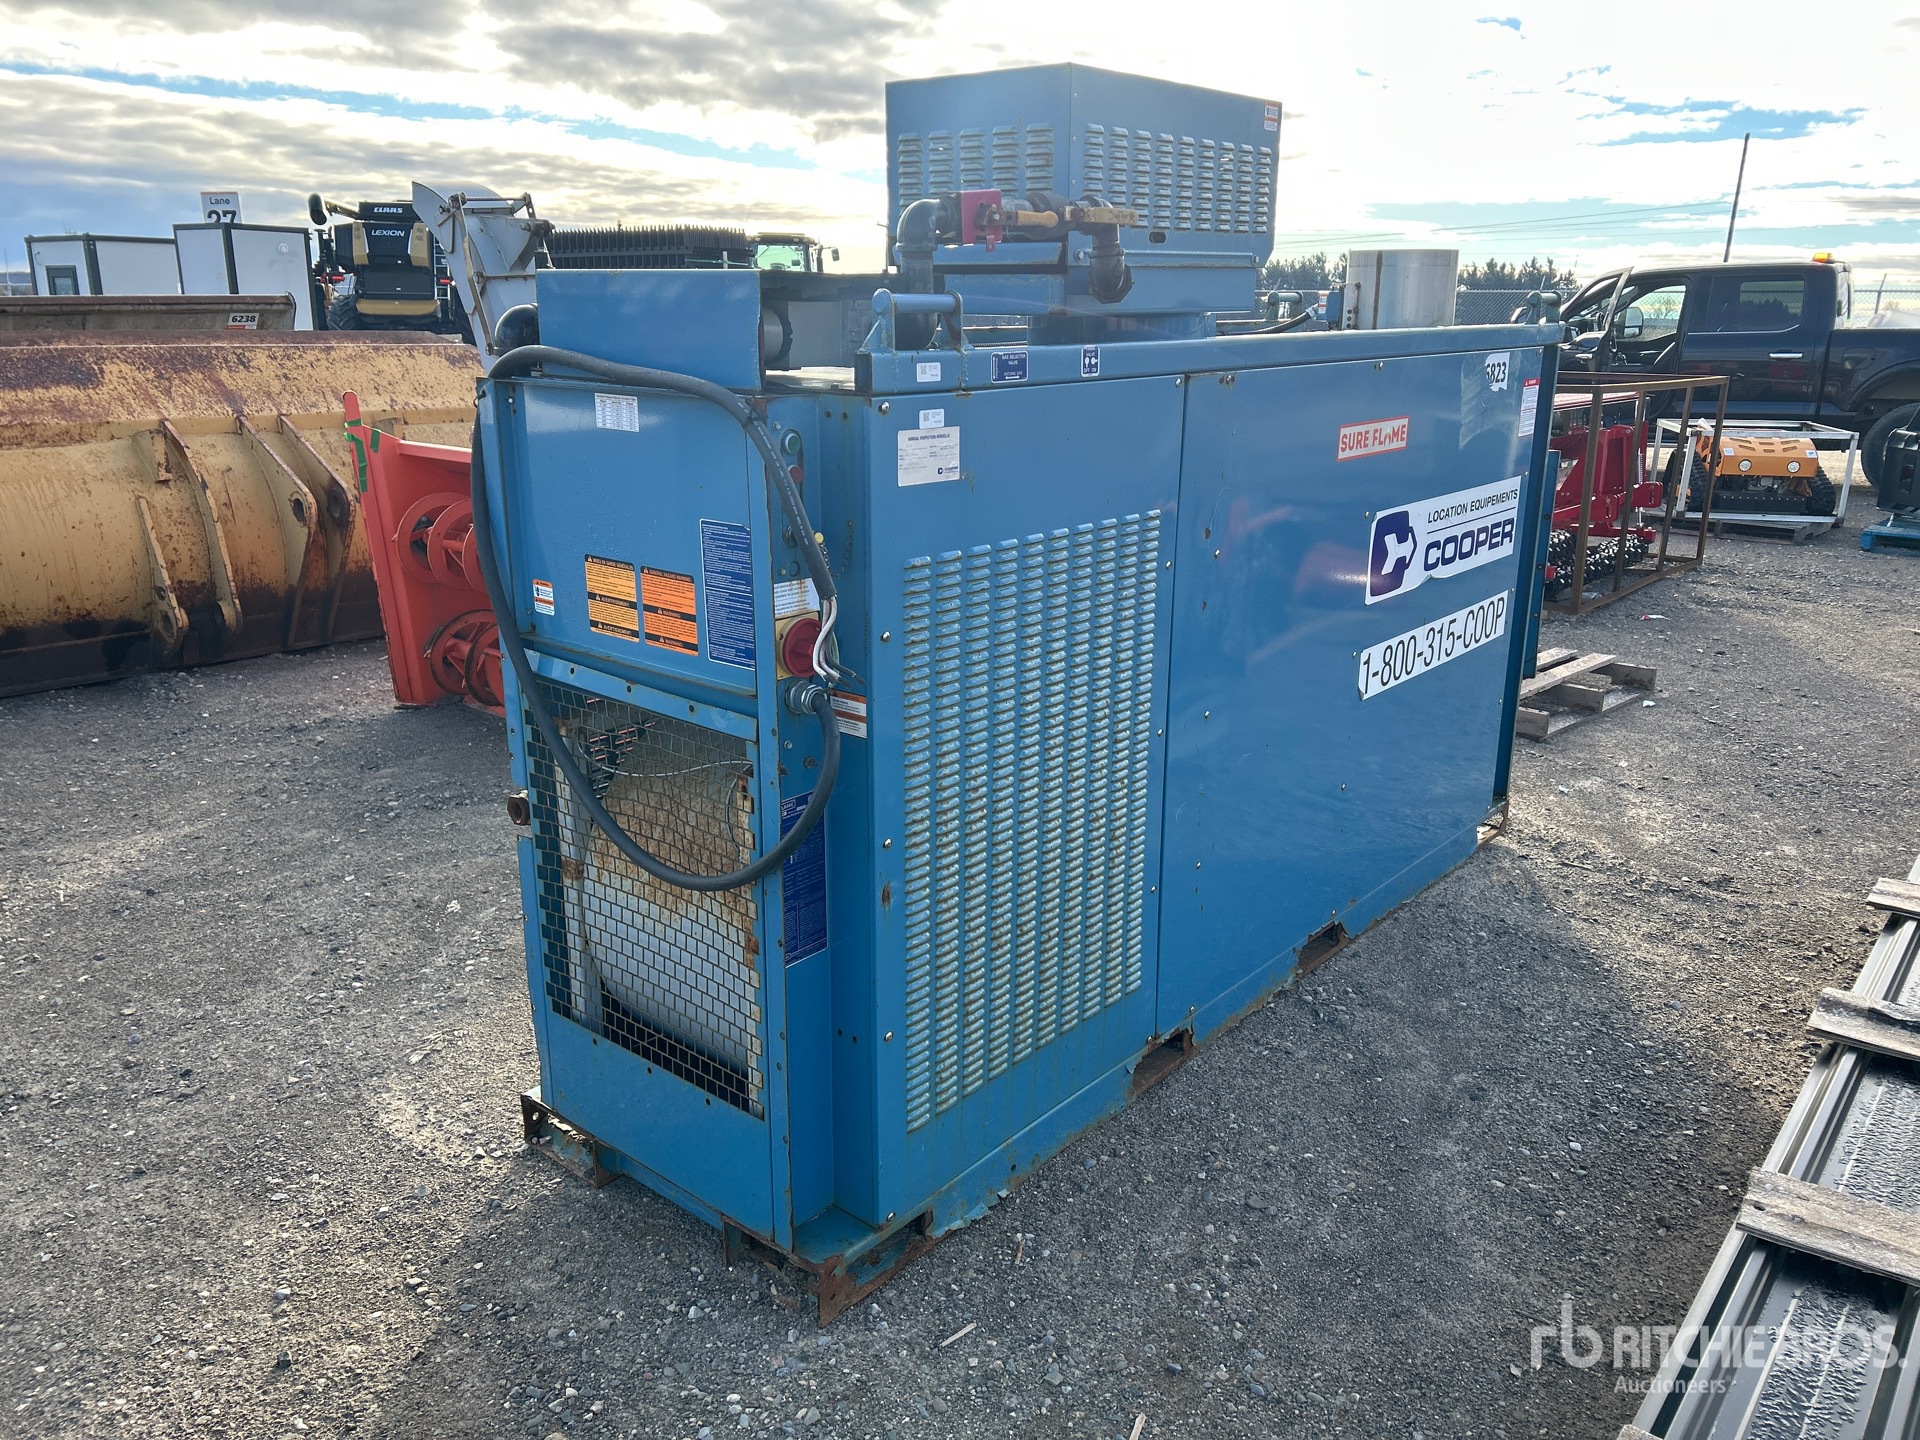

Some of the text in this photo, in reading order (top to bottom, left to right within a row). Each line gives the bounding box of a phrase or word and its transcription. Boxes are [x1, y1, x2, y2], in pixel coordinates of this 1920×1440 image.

[209, 197, 231, 205] Lane
[207, 209, 237, 224] 27
[371, 229, 405, 237] LEXION
[231, 315, 256, 323] 6238
[1340, 424, 1407, 453] SURE FLAME
[1427, 488, 1518, 523] LOCATION EQUIPEMENTS
[1424, 517, 1515, 571] COOPER
[1362, 596, 1505, 694] 1-800-315-COOP
